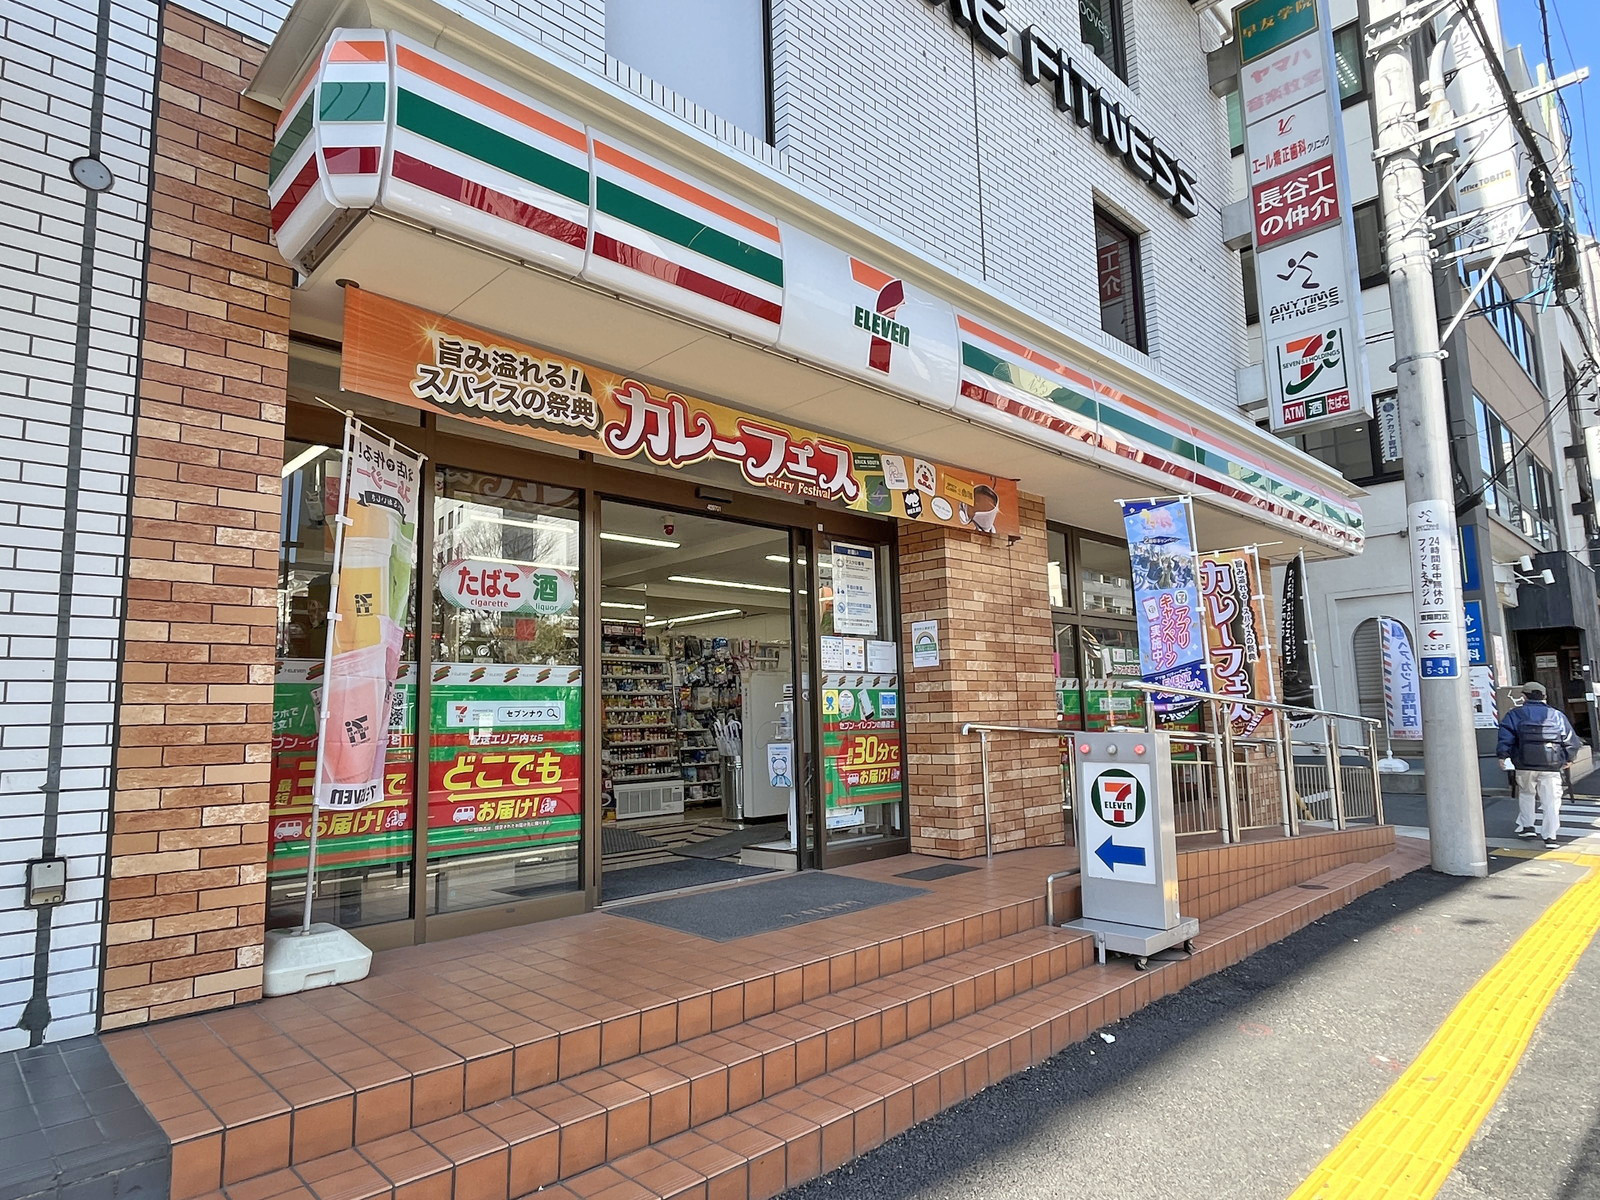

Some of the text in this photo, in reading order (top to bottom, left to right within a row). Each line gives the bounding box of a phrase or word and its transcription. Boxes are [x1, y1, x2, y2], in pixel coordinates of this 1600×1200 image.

[1021, 24, 1199, 218] FITNESS
[1257, 165, 1335, 214] 長谷工
[1260, 195, 1336, 236] の仲介
[1269, 286, 1339, 317] ANYTIME
[1271, 298, 1340, 324] FITNESS
[438, 337, 578, 392] 旨み溢れる!
[416, 366, 595, 424] スパイスの祭典
[1284, 395, 1349, 421] ATM 酒 たばこ
[608, 386, 858, 498] カレーフェス
[765, 474, 831, 500] Curry Festival
[458, 566, 558, 602] たばこ 酒
[470, 598, 559, 611] cigarette liquor
[1159, 593, 1177, 668] キャンペーン
[1175, 606, 1190, 649] アプリ
[506, 709, 544, 718] セブンナウ
[442, 751, 562, 791] どこでも
[476, 797, 539, 822] お届け!
